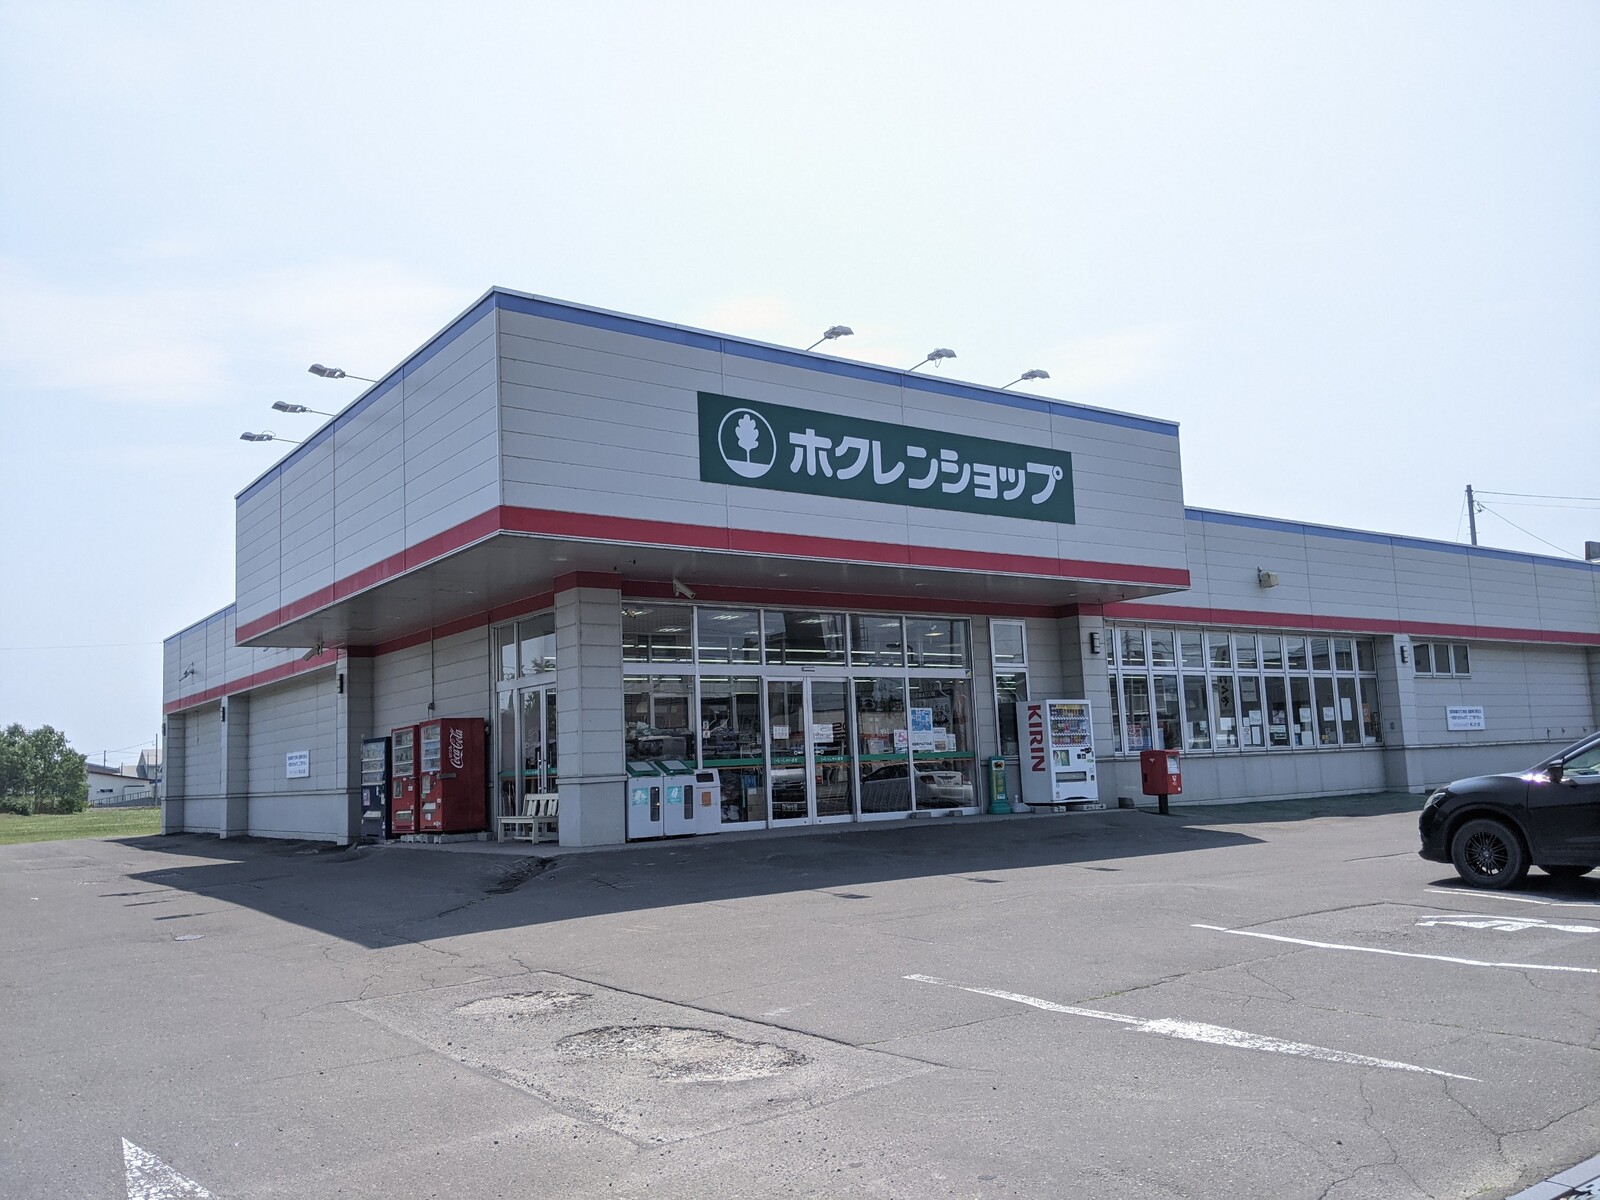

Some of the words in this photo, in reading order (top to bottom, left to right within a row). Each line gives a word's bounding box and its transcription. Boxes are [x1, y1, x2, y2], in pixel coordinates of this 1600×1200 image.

[789, 428, 1063, 505] ホクレンショップ
[1027, 704, 1046, 772] KIRIN
